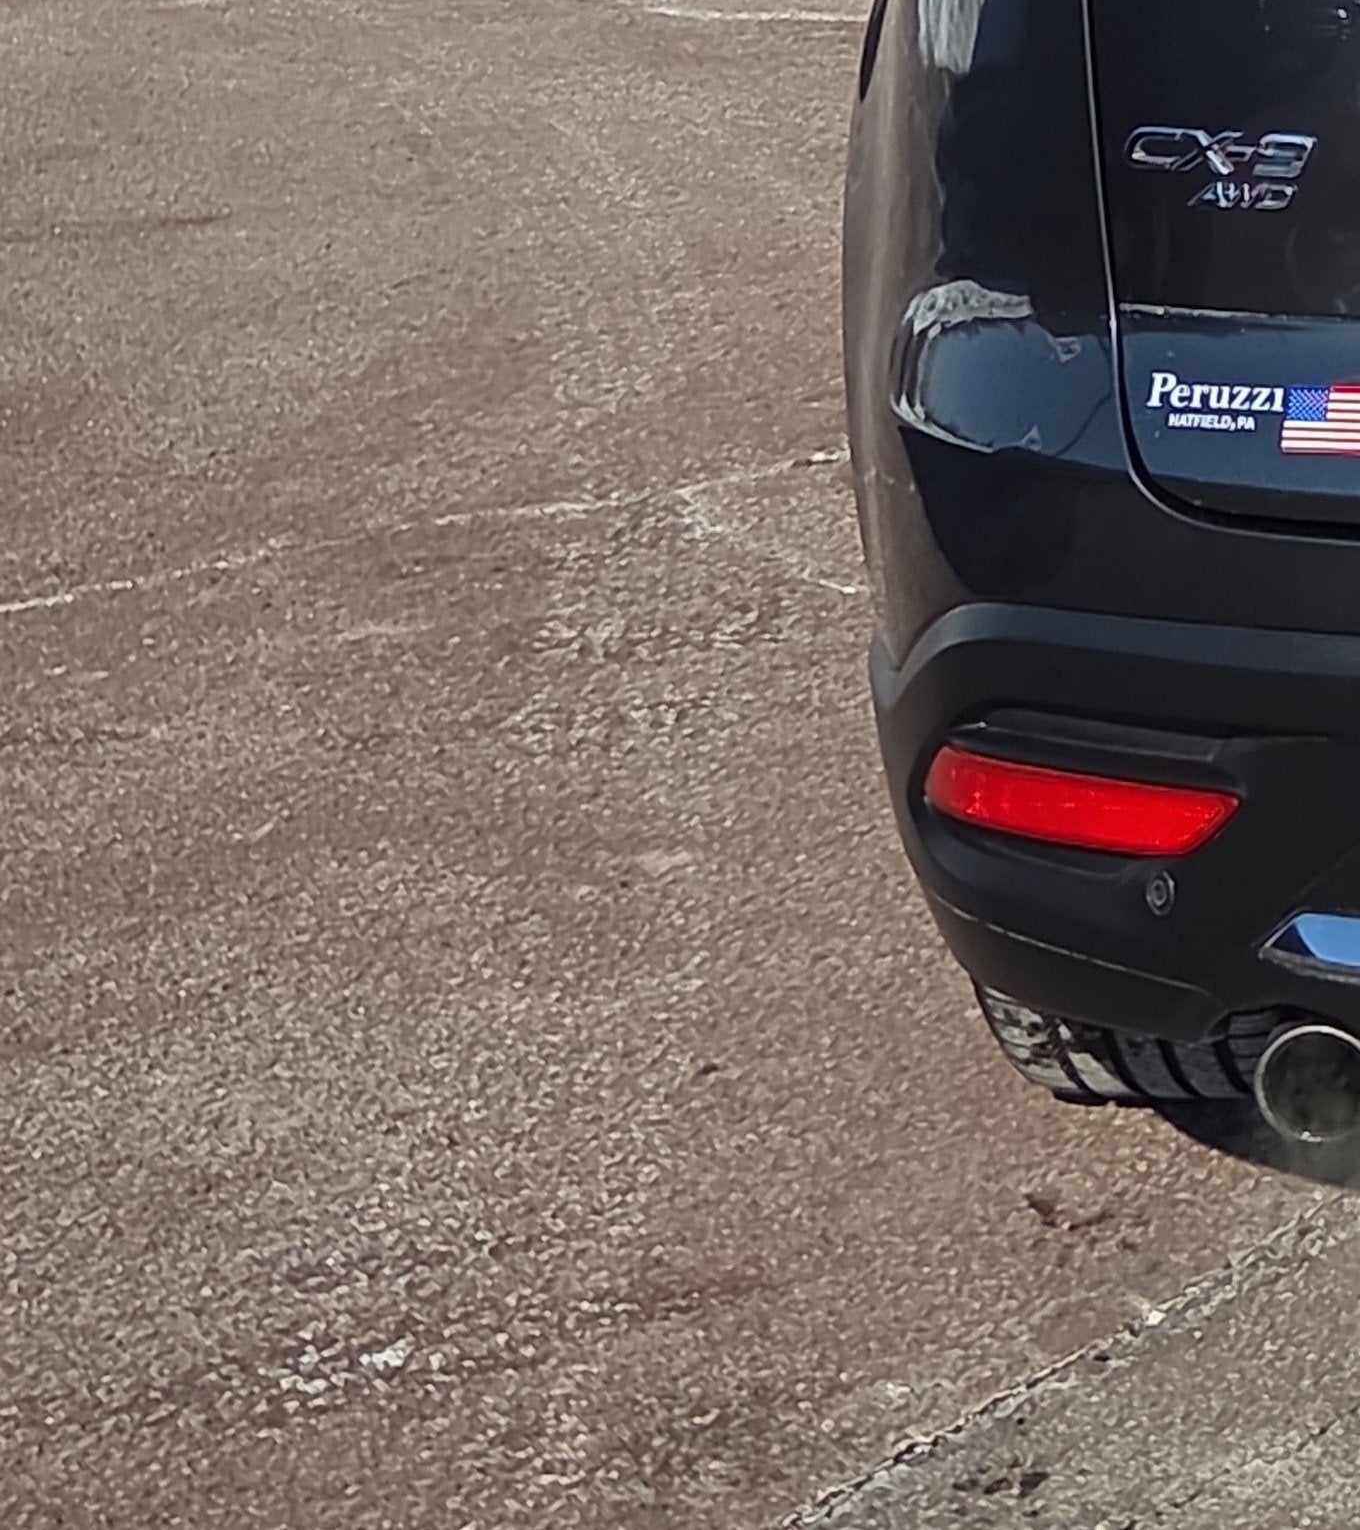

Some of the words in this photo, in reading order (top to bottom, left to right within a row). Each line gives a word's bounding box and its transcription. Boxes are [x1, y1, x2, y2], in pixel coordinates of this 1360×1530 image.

[1124, 125, 1318, 179] CX-9
[1187, 180, 1298, 211] AWD
[1145, 371, 1285, 413] Peruzzi
